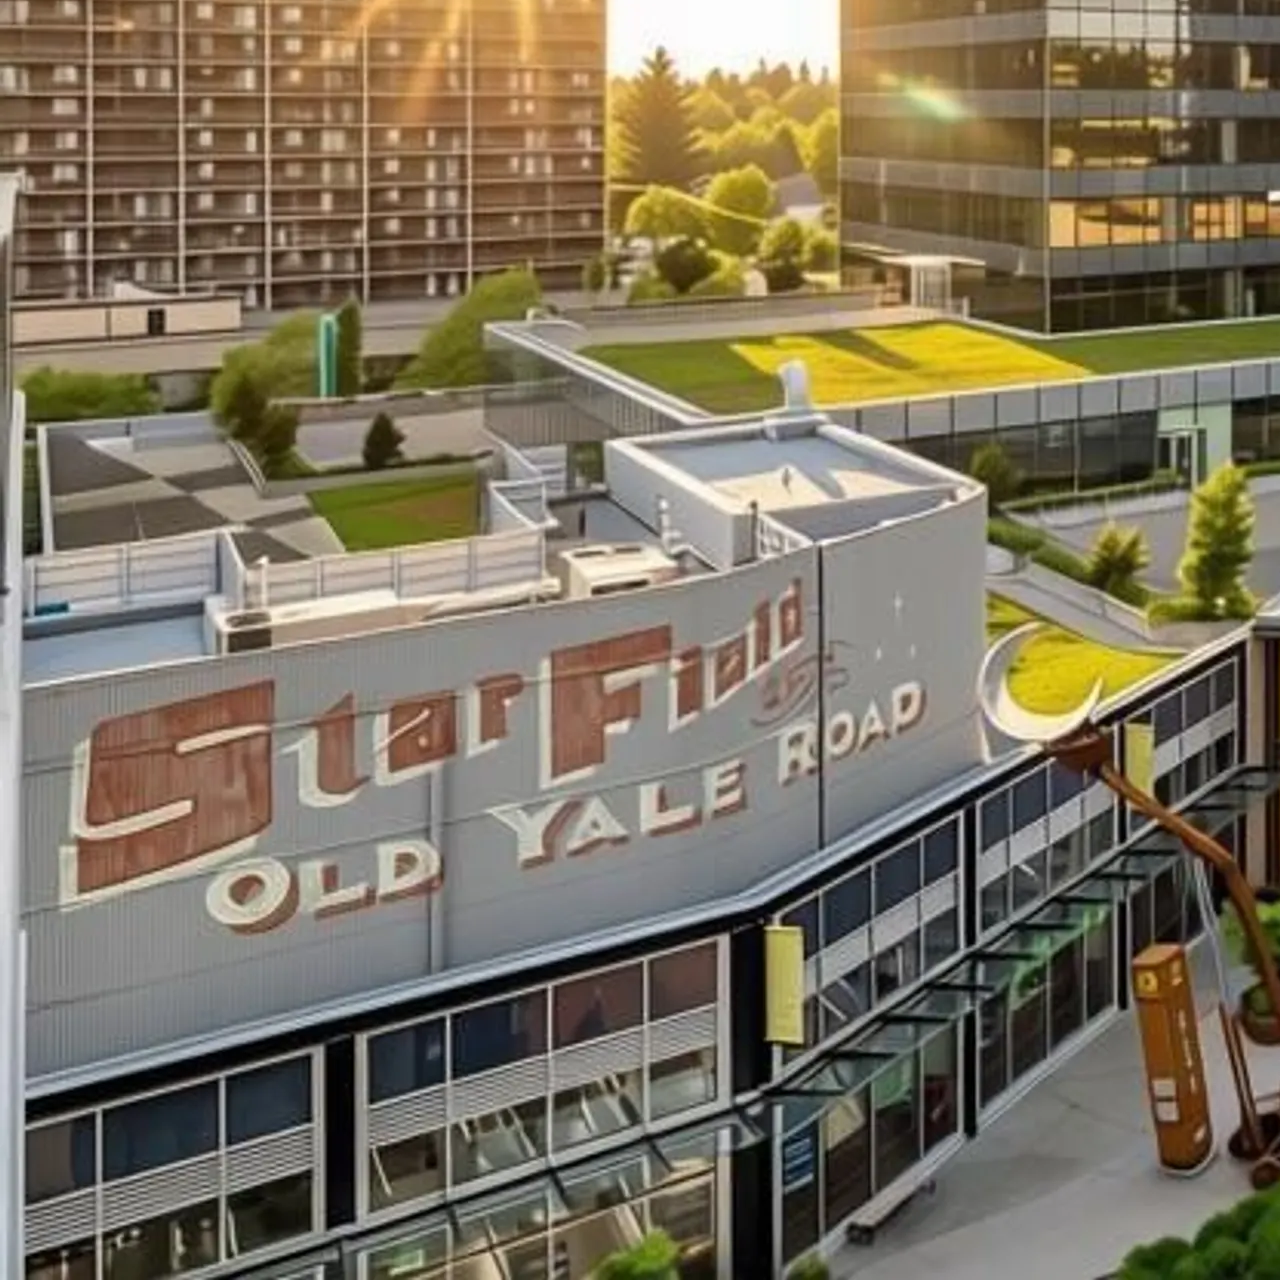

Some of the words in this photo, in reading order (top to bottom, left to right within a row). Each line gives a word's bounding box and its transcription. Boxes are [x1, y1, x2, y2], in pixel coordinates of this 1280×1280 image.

[205, 838, 444, 934] OLD
[483, 757, 748, 870] YALE
[778, 679, 927, 787] ROAD
